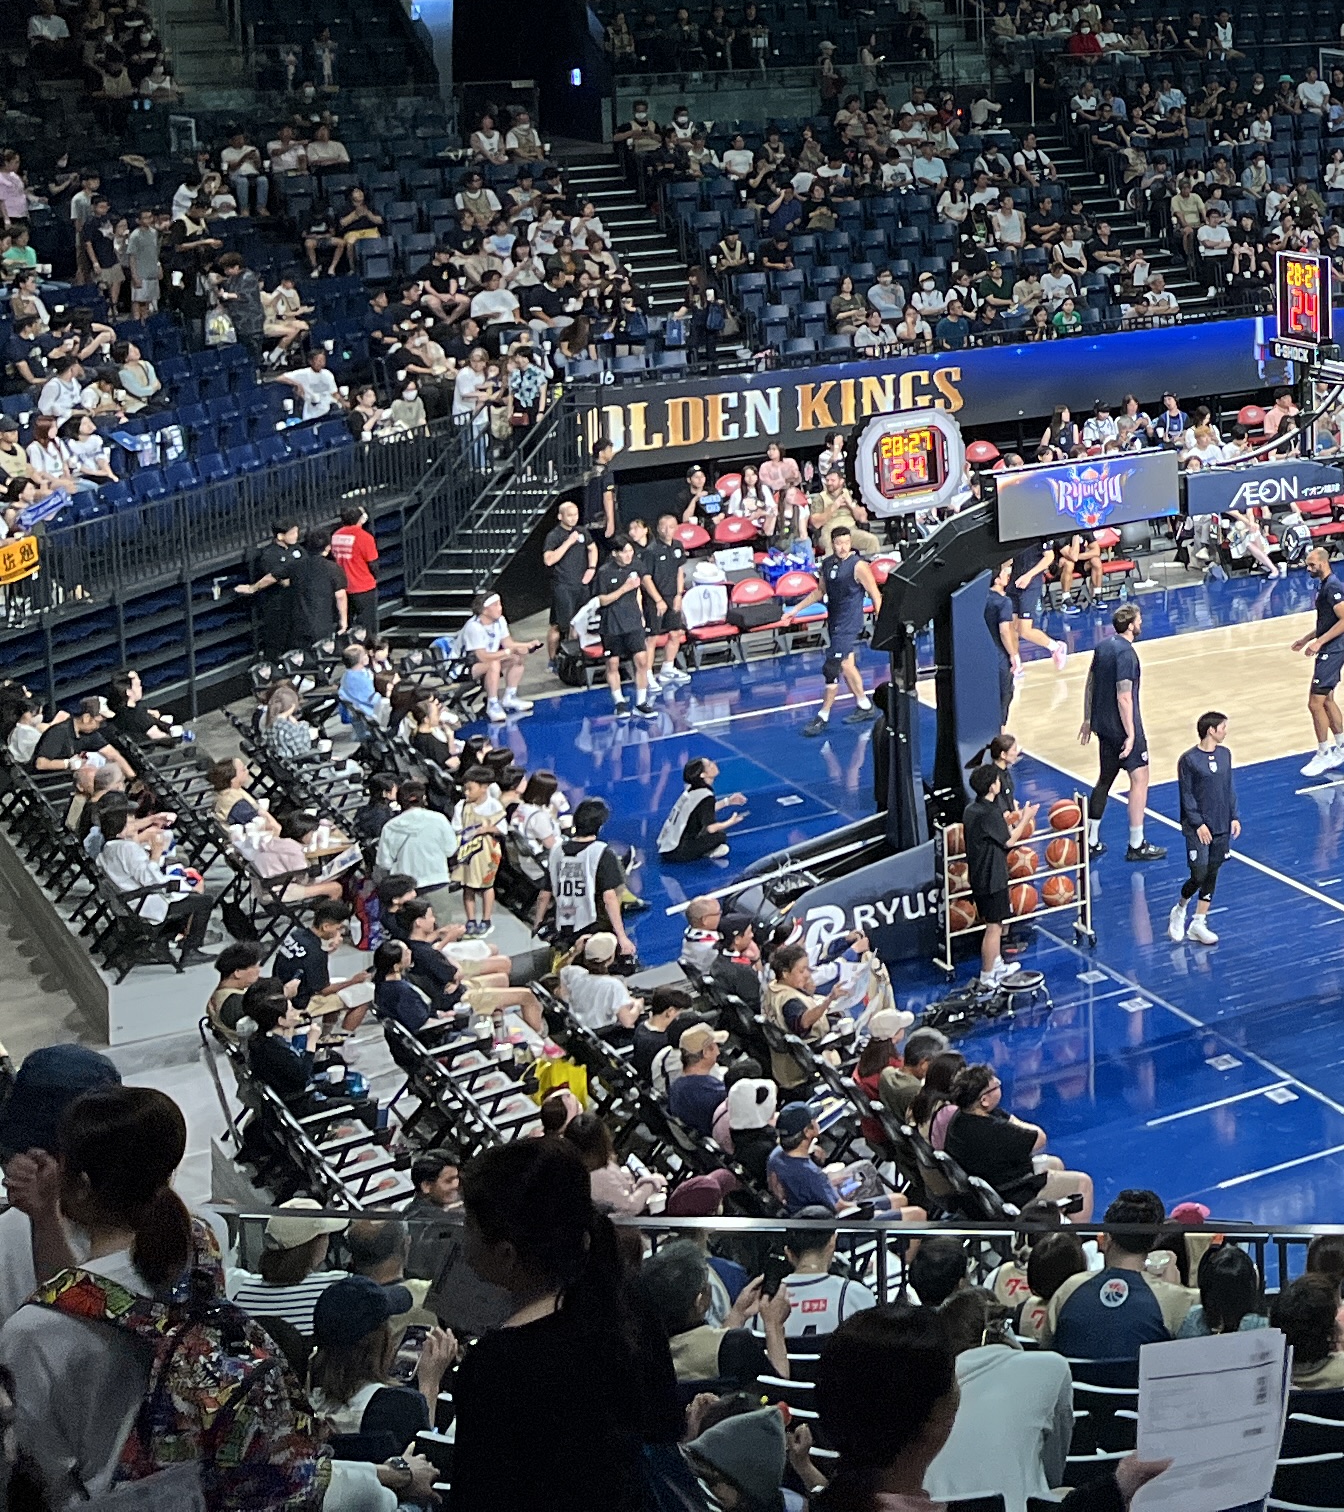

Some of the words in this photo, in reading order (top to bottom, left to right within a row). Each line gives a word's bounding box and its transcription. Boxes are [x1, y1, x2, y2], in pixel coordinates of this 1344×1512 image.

[1290, 288, 1318, 332] 24
[577, 388, 782, 456] OLDEN
[796, 368, 965, 432] KINGS
[881, 431, 933, 459] 28:27
[890, 456, 926, 486] 24
